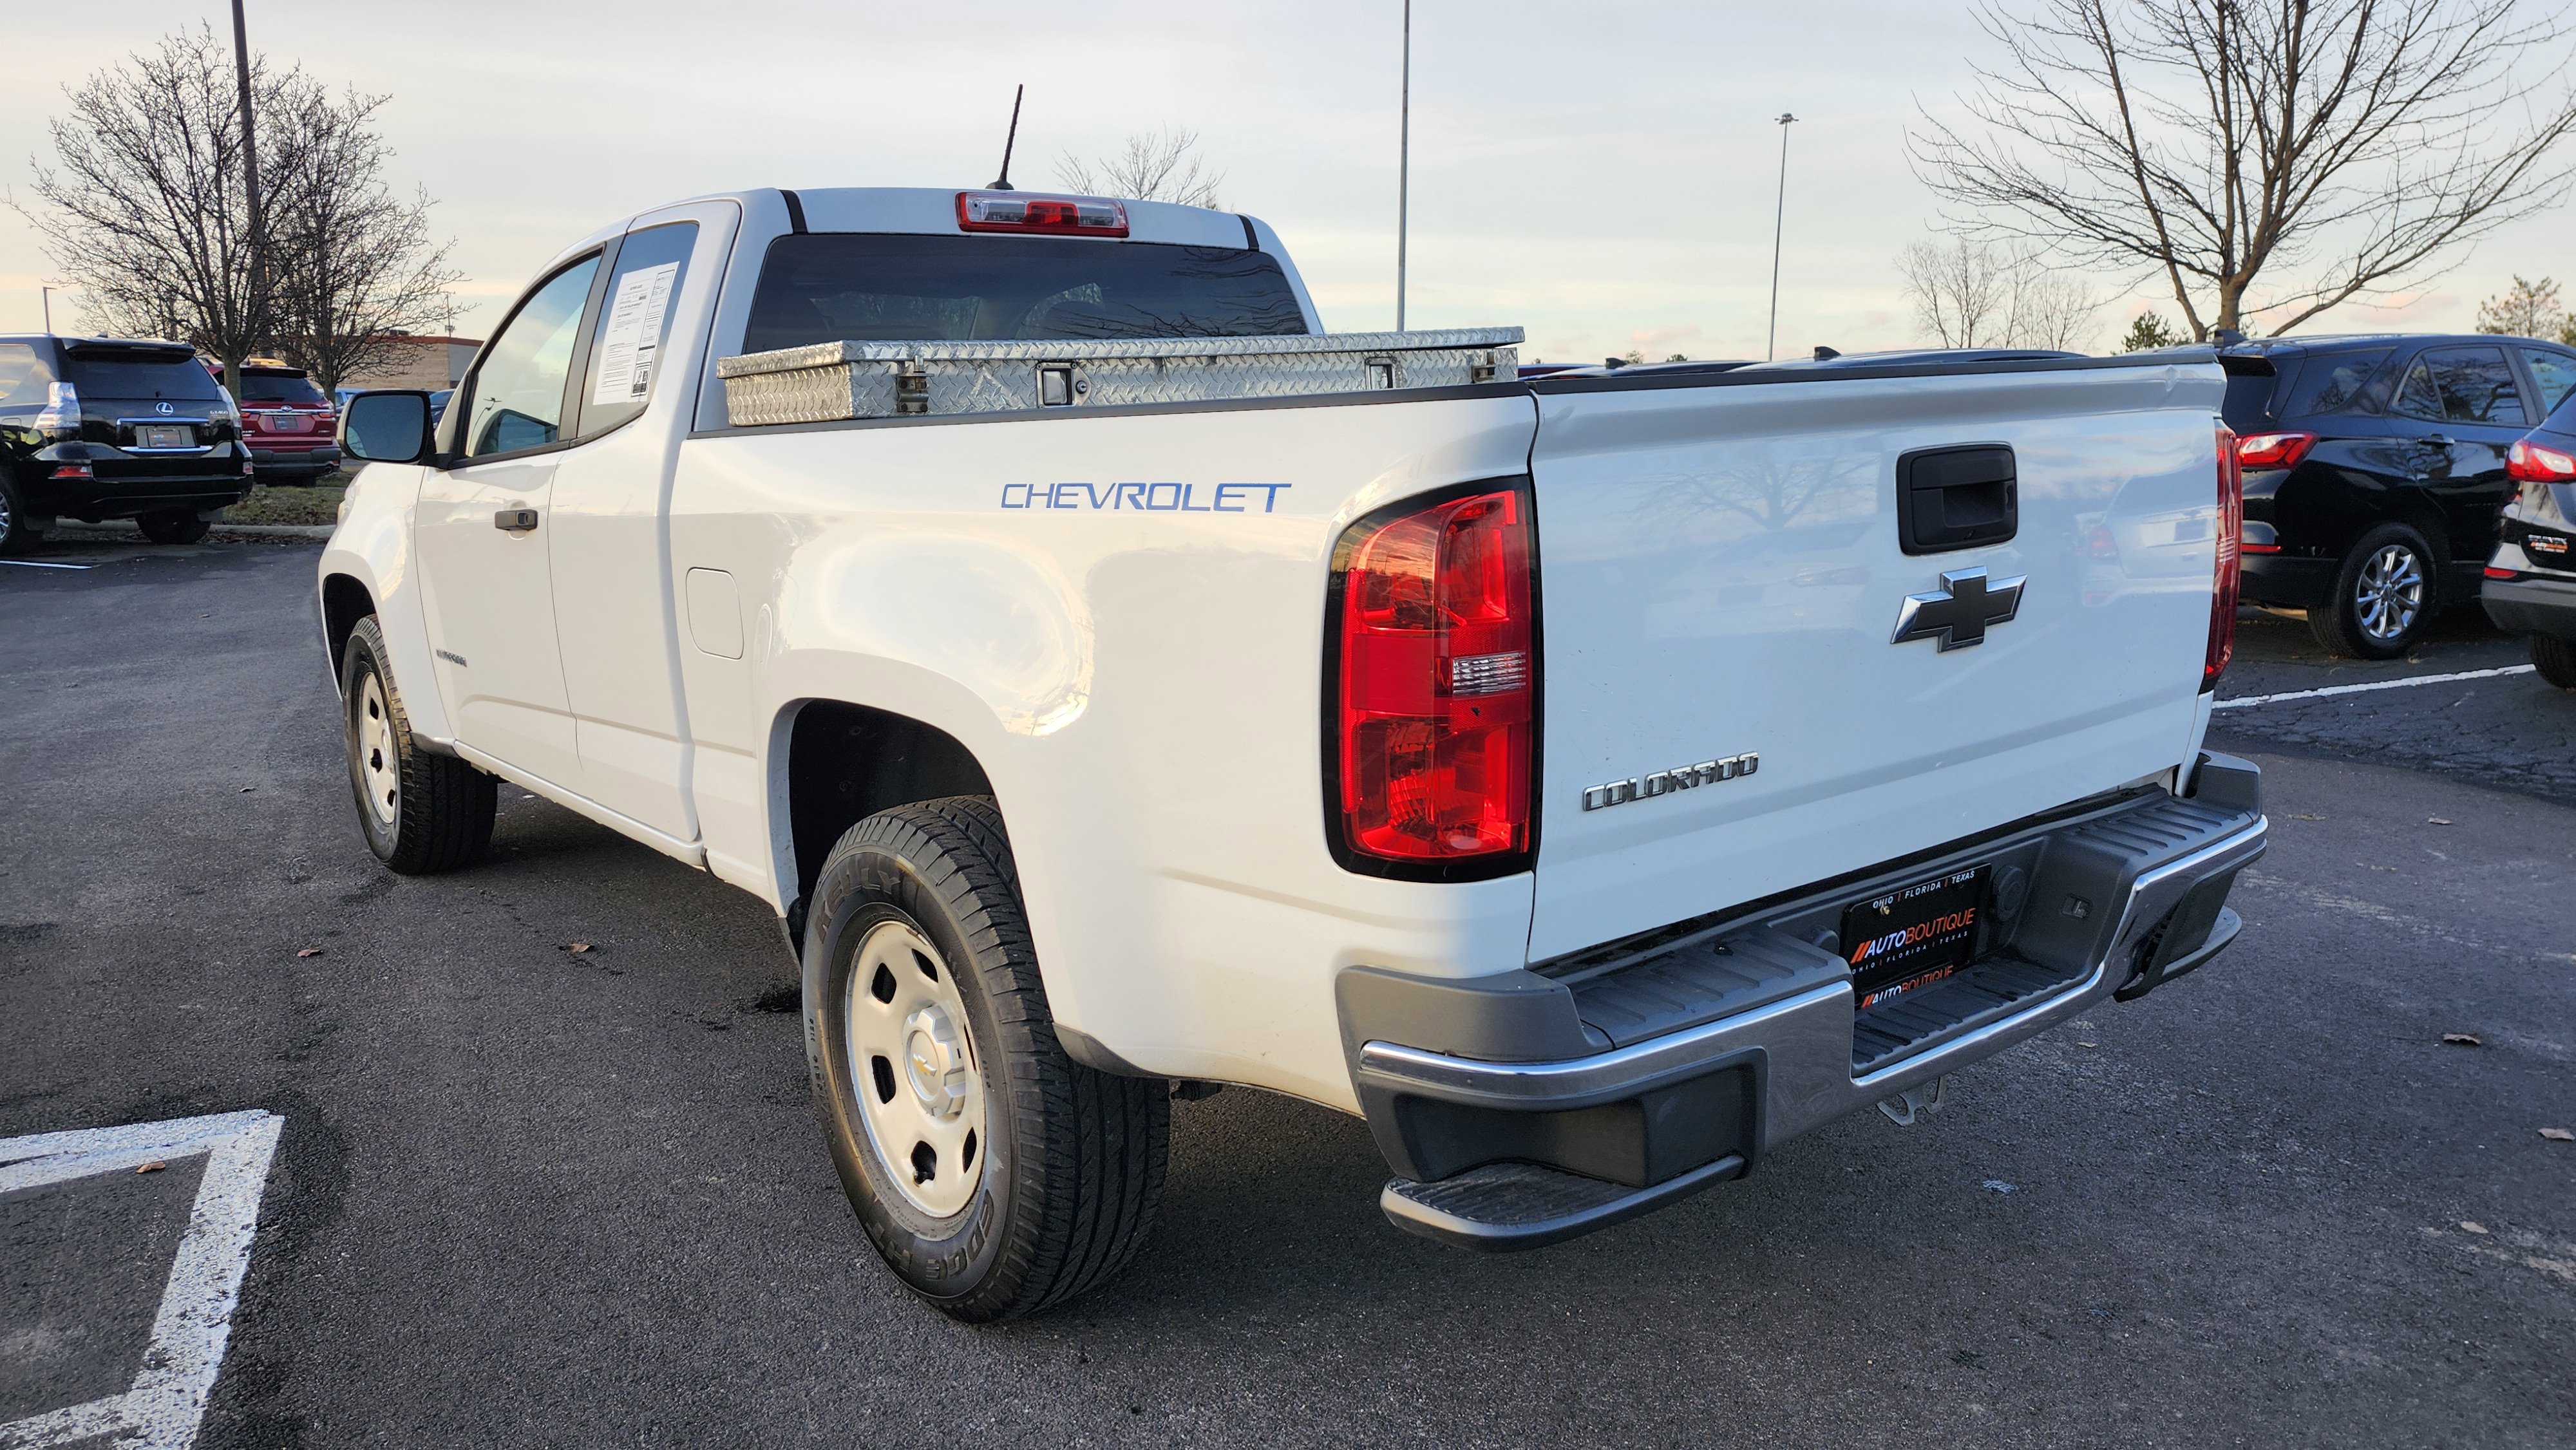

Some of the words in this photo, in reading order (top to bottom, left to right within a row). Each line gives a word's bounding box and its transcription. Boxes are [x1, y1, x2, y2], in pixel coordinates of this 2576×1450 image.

[1001, 482, 1293, 513] CHEVROLET
[1582, 750, 1759, 811] COLORADO
[815, 867, 901, 944] KELLY
[1873, 896, 1893, 909] OHIO
[1904, 881, 1941, 899] FLORIDA
[1951, 870, 1975, 885] TEXAS
[1852, 962, 1875, 975] OHIO
[1886, 945, 1927, 963] FLORIDA
[1939, 930, 1967, 945] TEXAS
[1864, 908, 1976, 959] AUTOBOUTIQUE
[925, 1188, 995, 1281] EDGE
